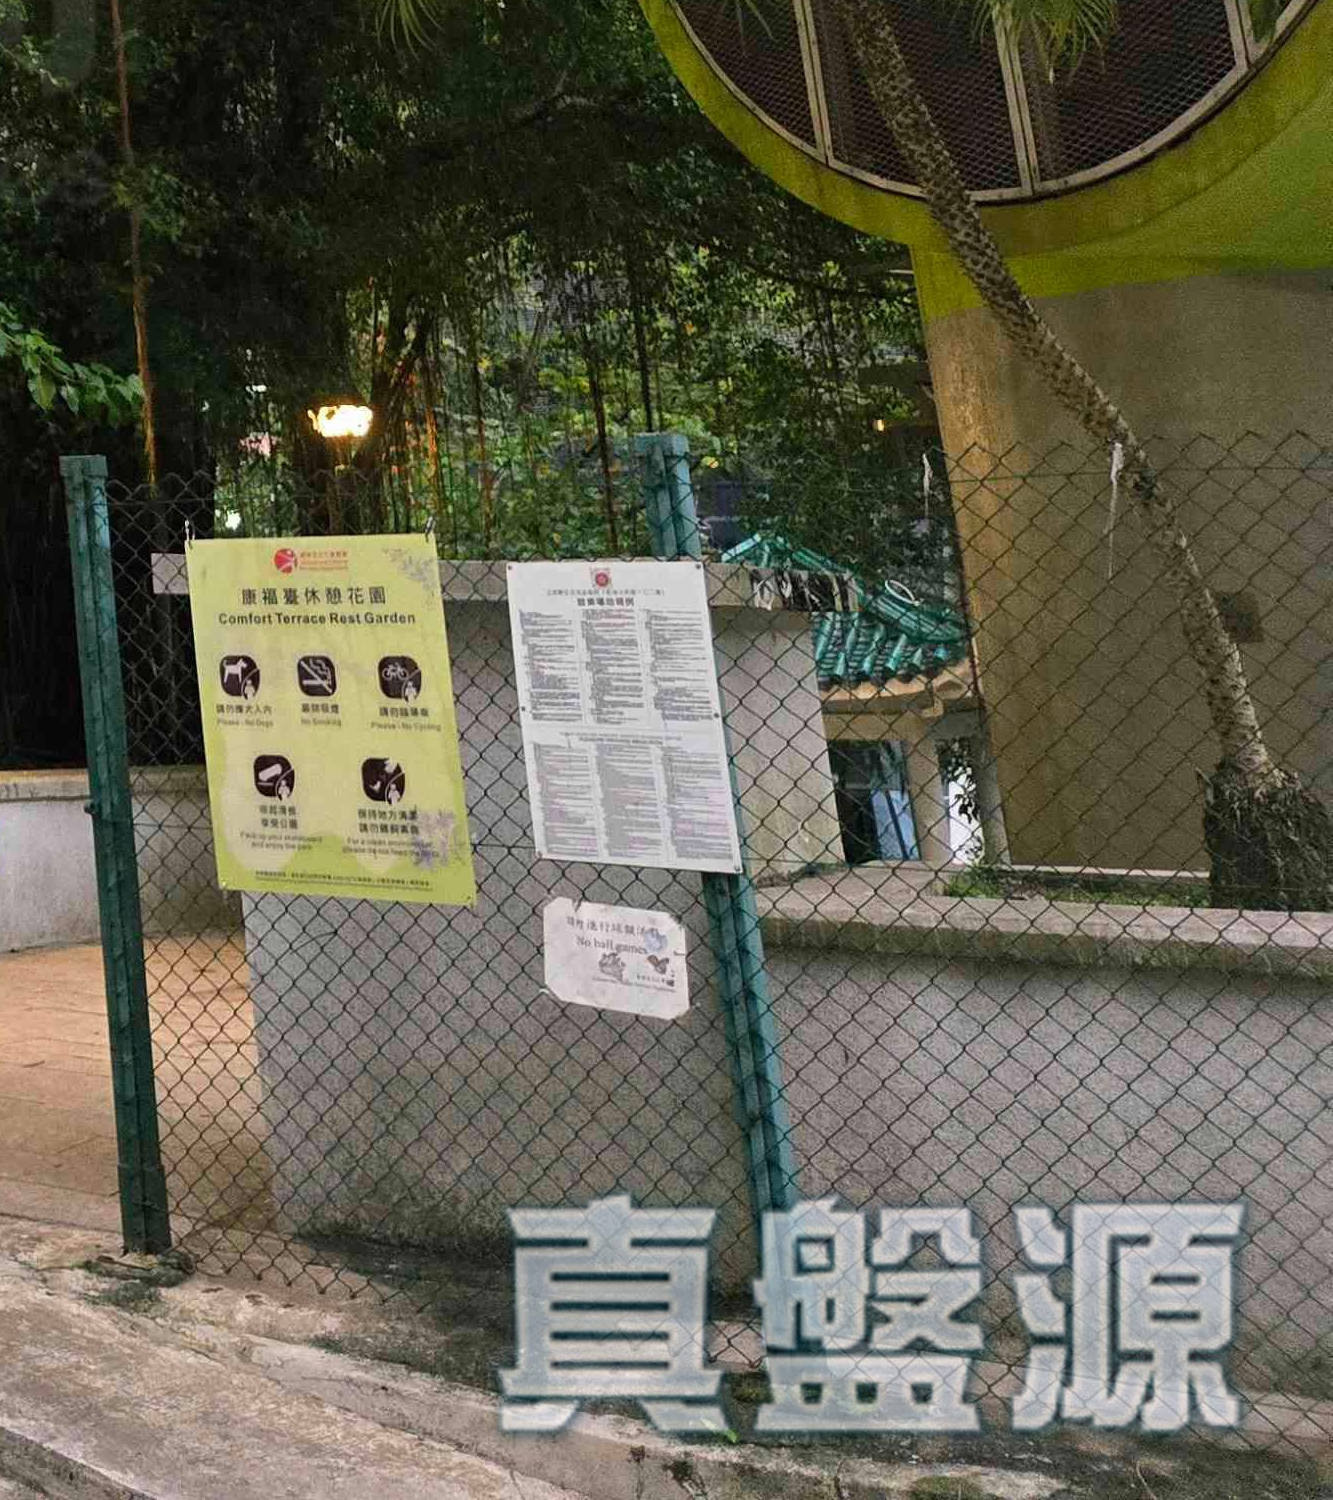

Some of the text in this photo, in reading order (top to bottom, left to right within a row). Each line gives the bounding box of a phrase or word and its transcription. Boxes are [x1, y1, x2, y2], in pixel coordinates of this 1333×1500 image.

[218, 611, 416, 625] Comfort Terrace Rest Garden
[576, 935, 591, 947] No
[593, 937, 614, 950] ball
